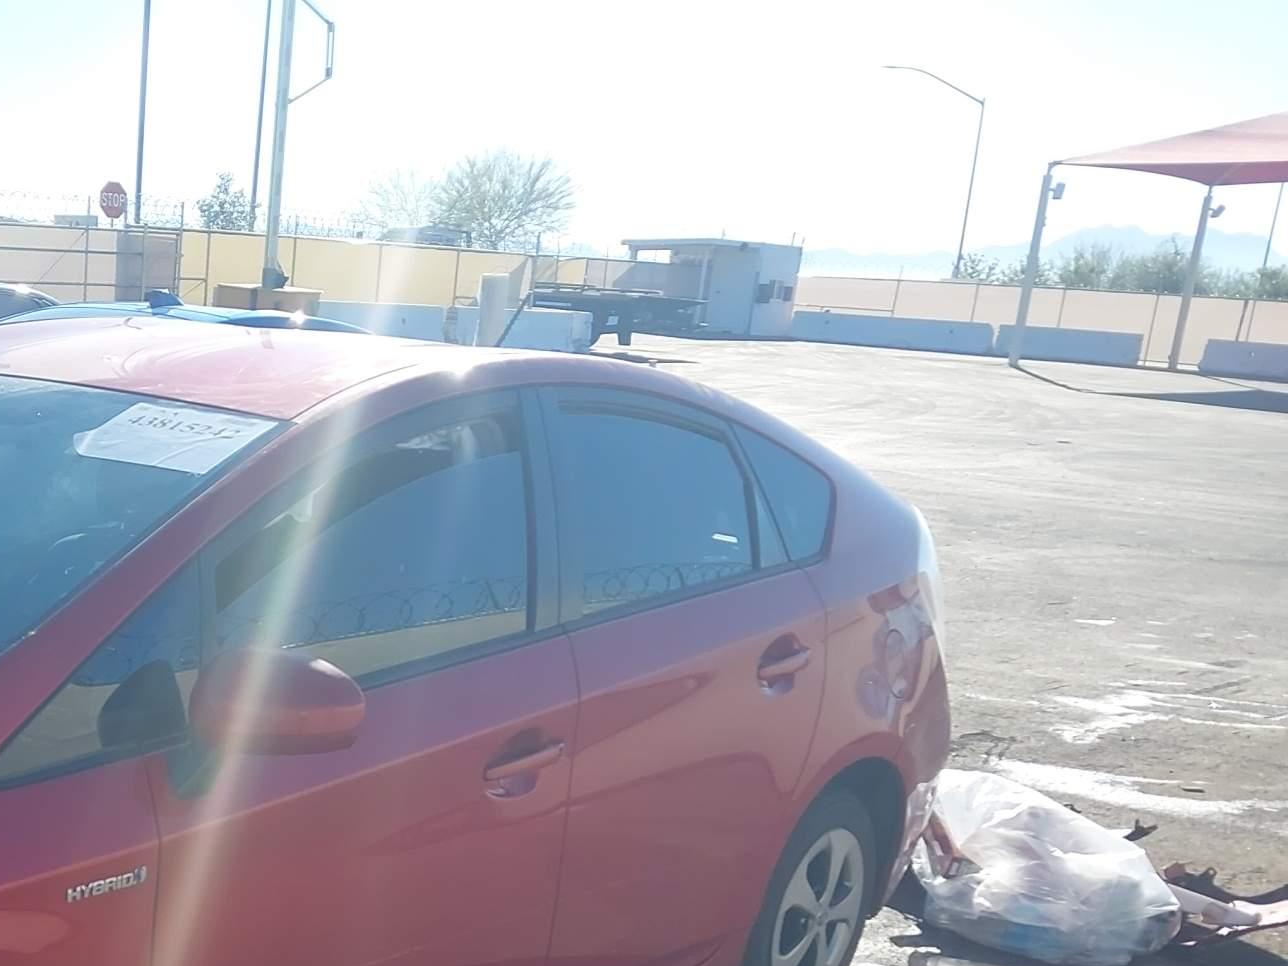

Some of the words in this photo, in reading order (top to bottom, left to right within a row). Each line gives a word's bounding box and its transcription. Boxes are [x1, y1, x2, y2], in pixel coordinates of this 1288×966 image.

[102, 191, 126, 207] STOP
[127, 415, 241, 439] 43815242
[66, 871, 134, 904] HYBRID
